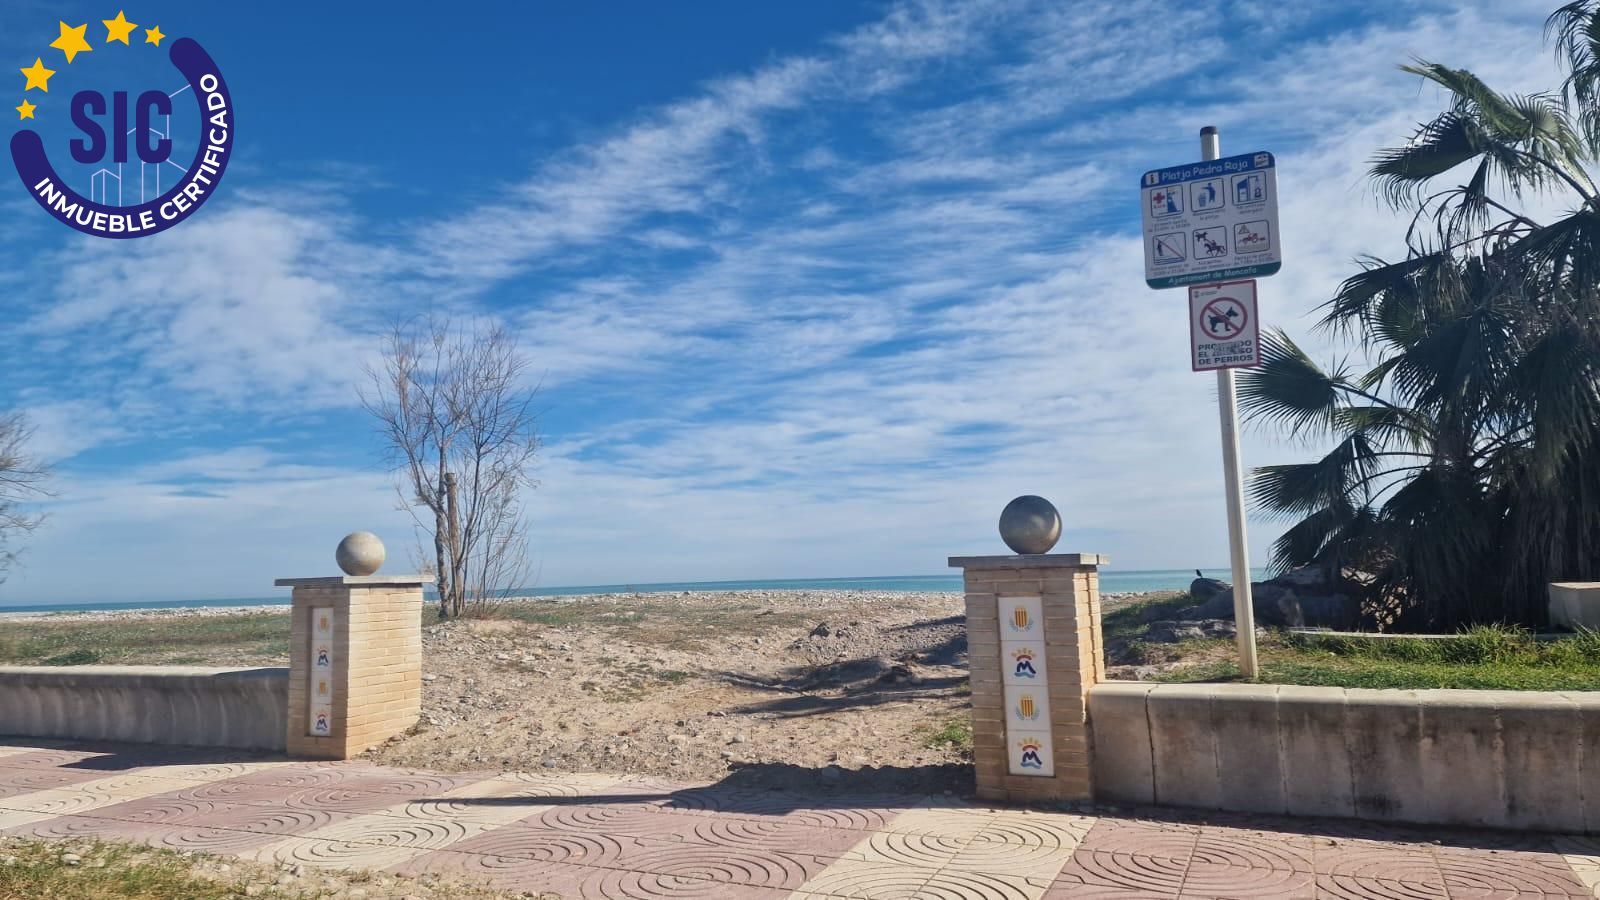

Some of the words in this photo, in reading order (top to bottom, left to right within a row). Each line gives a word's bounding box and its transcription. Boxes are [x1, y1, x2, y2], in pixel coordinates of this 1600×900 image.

[1162, 169, 1191, 181] Platja
[1193, 163, 1223, 177] Pedra
[1224, 160, 1249, 171] Roja
[1214, 355, 1253, 363] PERROS
